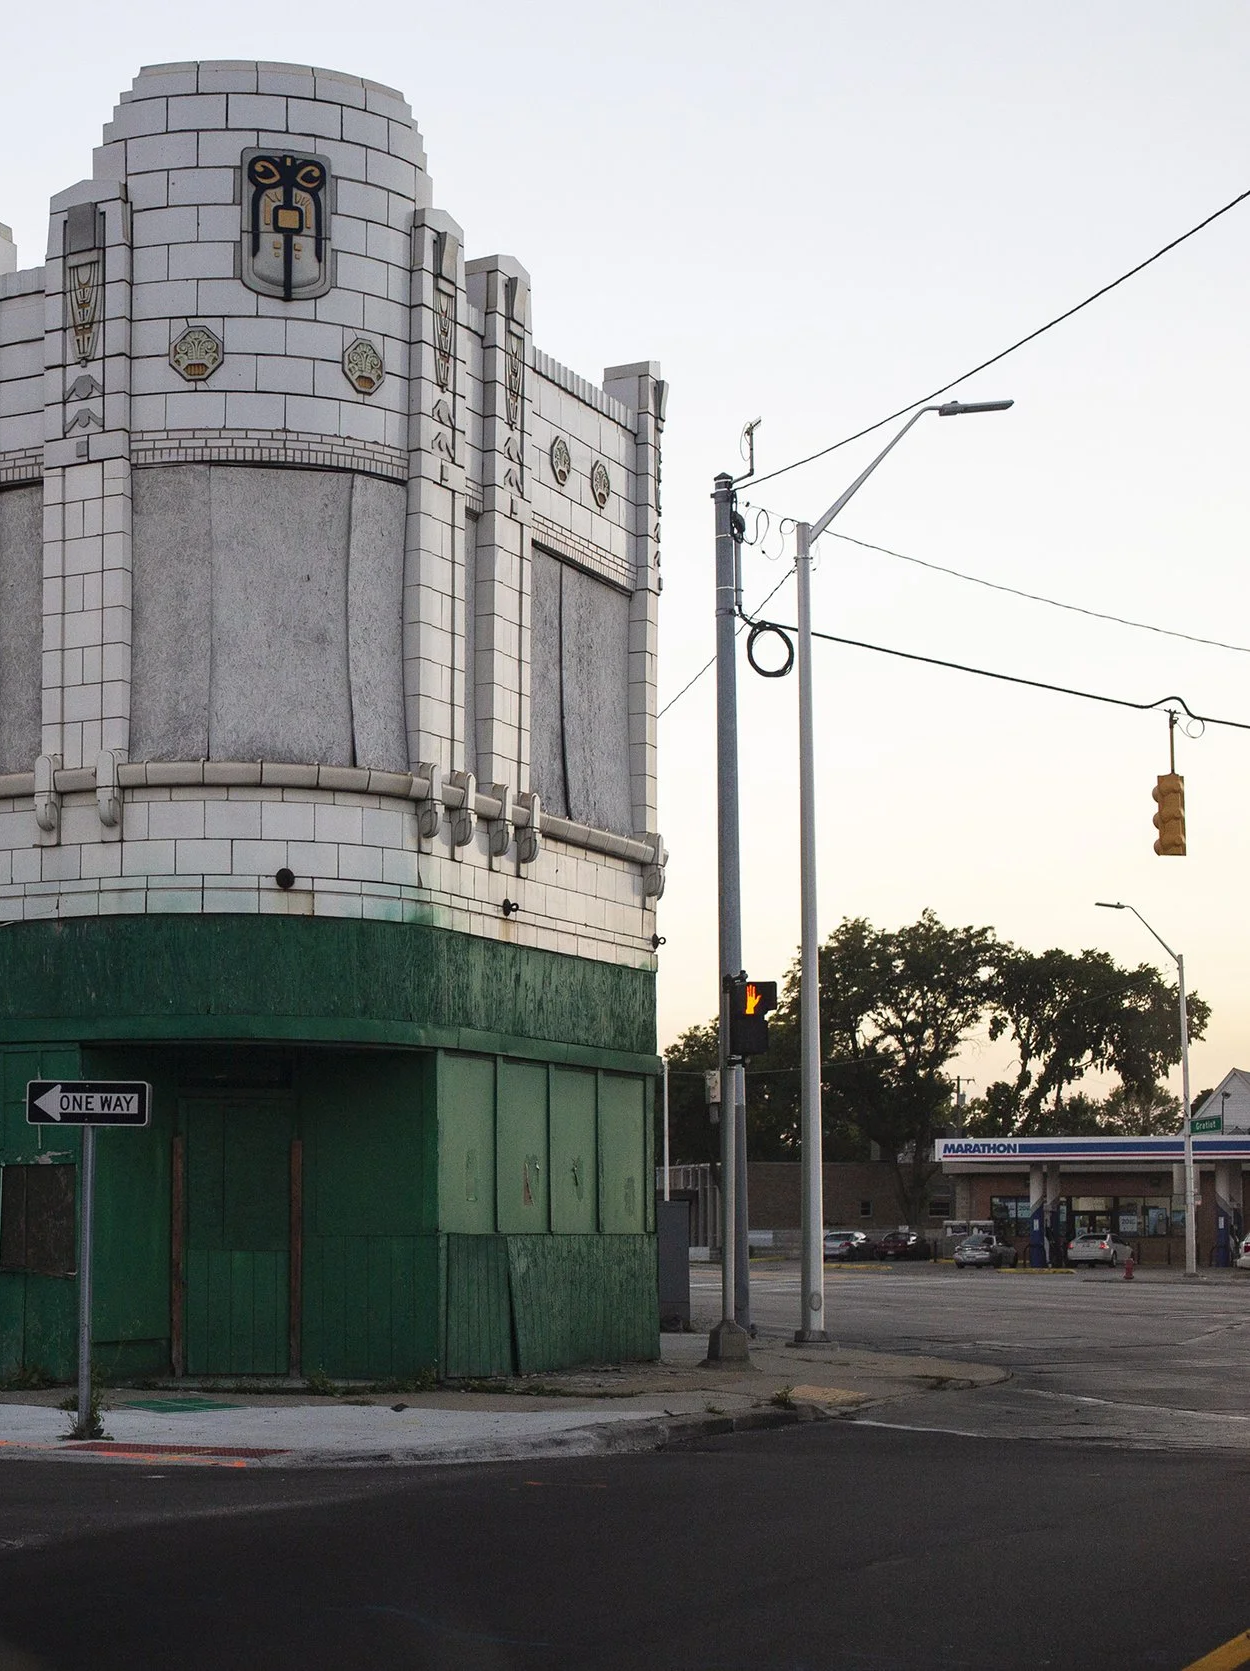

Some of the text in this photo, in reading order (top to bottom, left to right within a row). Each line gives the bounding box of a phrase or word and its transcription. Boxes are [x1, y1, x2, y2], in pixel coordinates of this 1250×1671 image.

[60, 1095, 134, 1112] ONE WAY
[943, 1143, 1017, 1153] MARATHON
